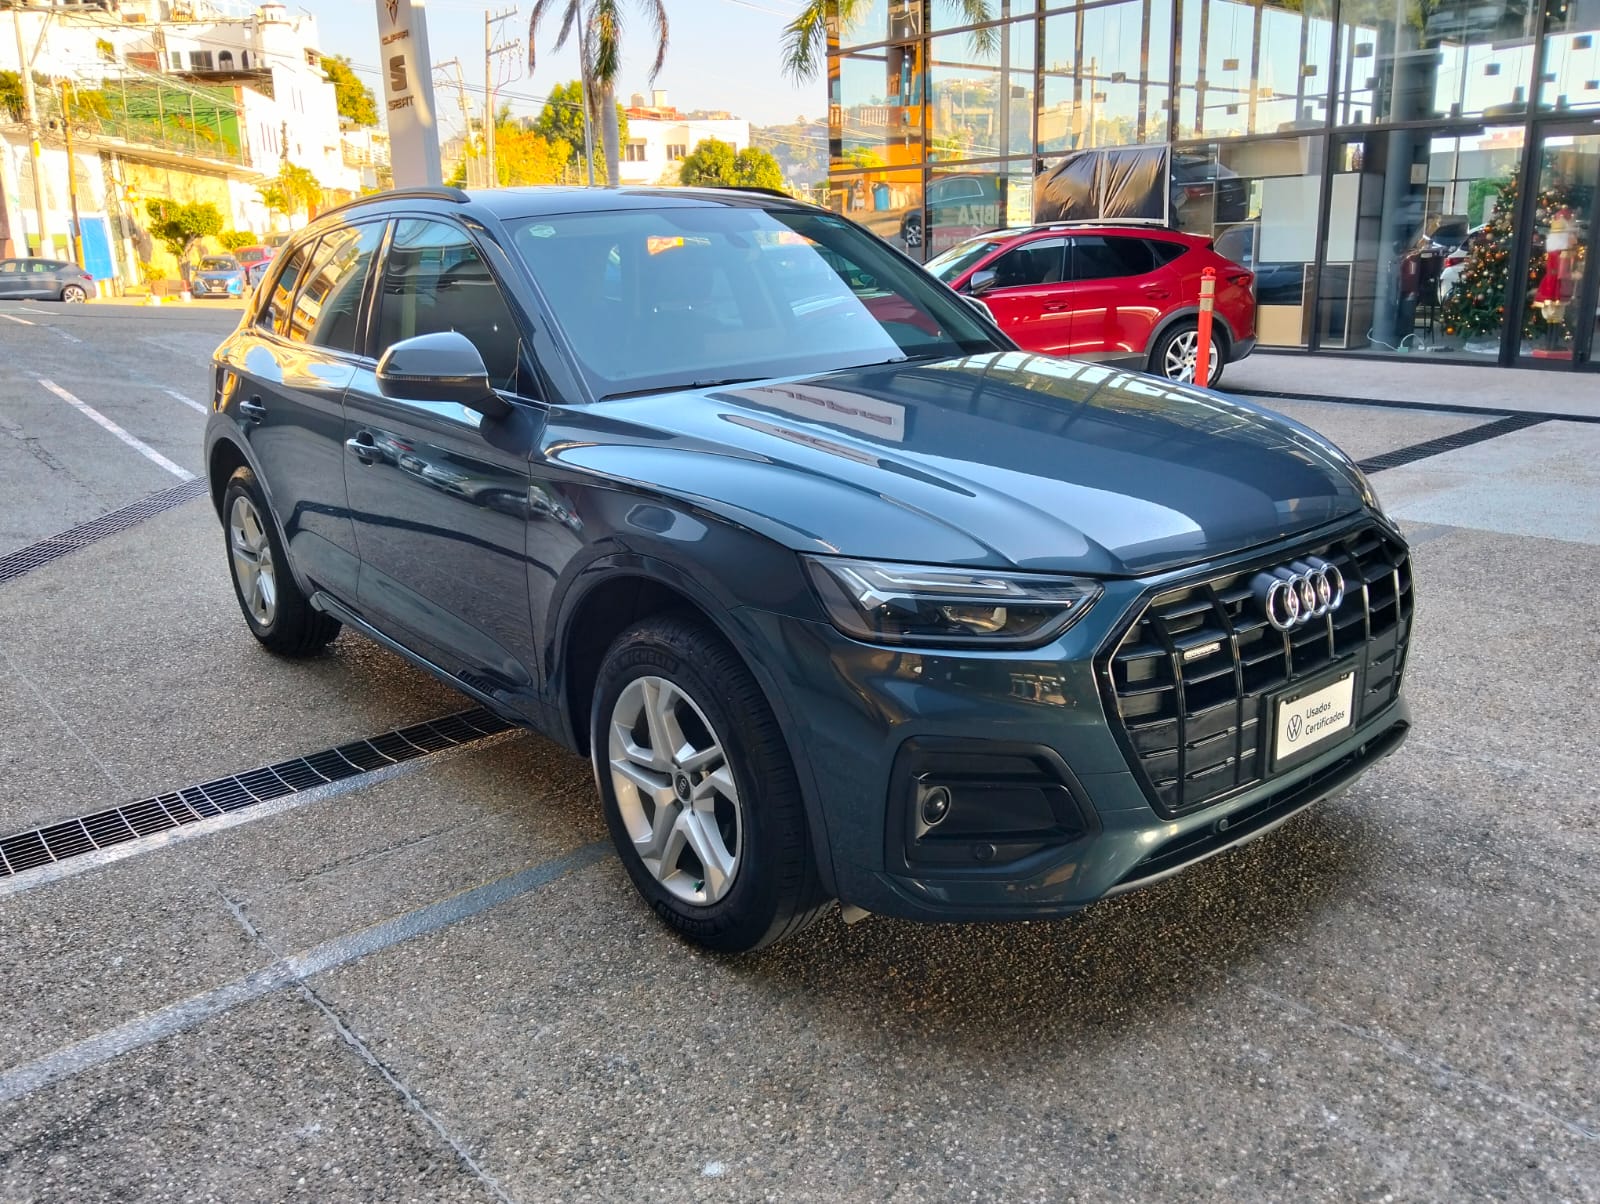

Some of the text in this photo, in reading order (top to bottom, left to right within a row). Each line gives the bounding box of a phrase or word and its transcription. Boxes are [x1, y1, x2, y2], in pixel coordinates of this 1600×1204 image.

[388, 95, 414, 111] SEAT
[617, 648, 678, 674] MICHELIN
[1306, 702, 1331, 719] Usados
[1305, 710, 1345, 735] Certificados
